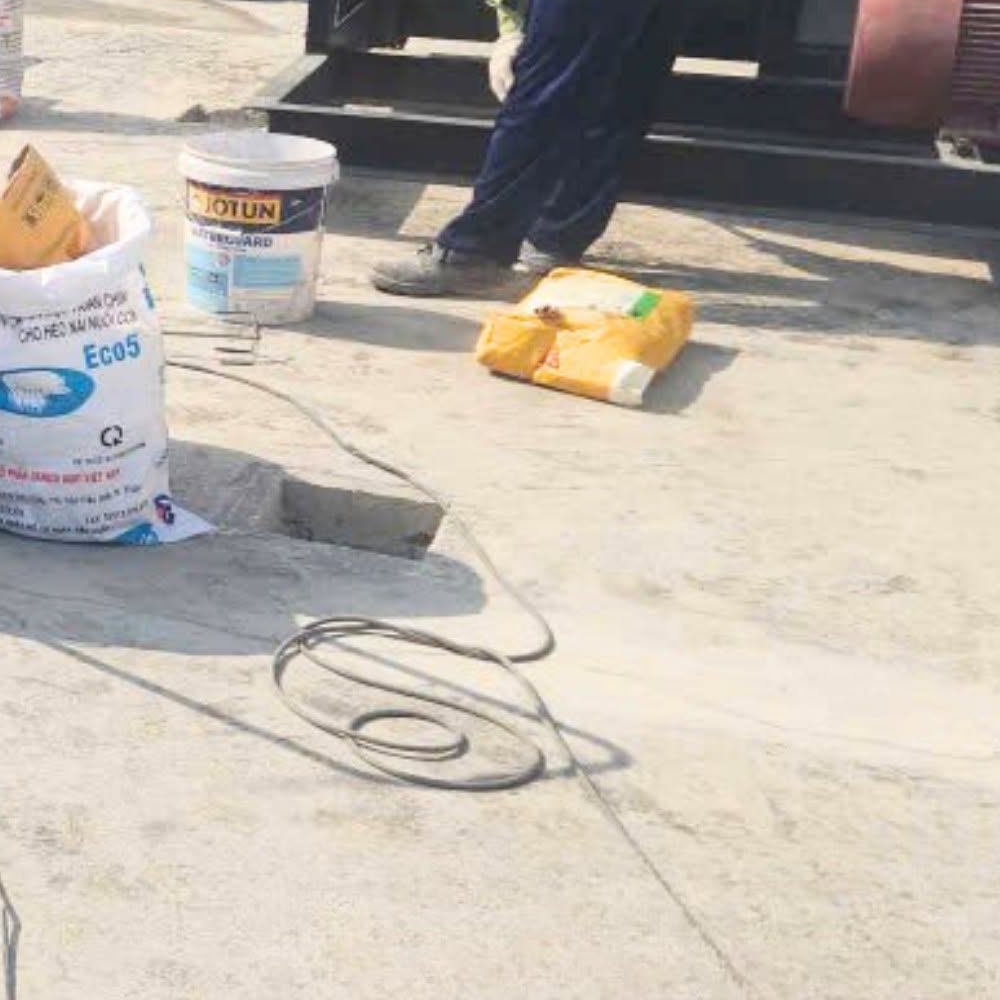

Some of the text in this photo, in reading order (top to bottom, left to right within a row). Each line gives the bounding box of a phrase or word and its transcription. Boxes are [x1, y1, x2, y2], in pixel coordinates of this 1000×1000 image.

[205, 198, 276, 220] JOTUN
[191, 229, 274, 248] TERGUARD
[83, 333, 141, 369] Eco5
